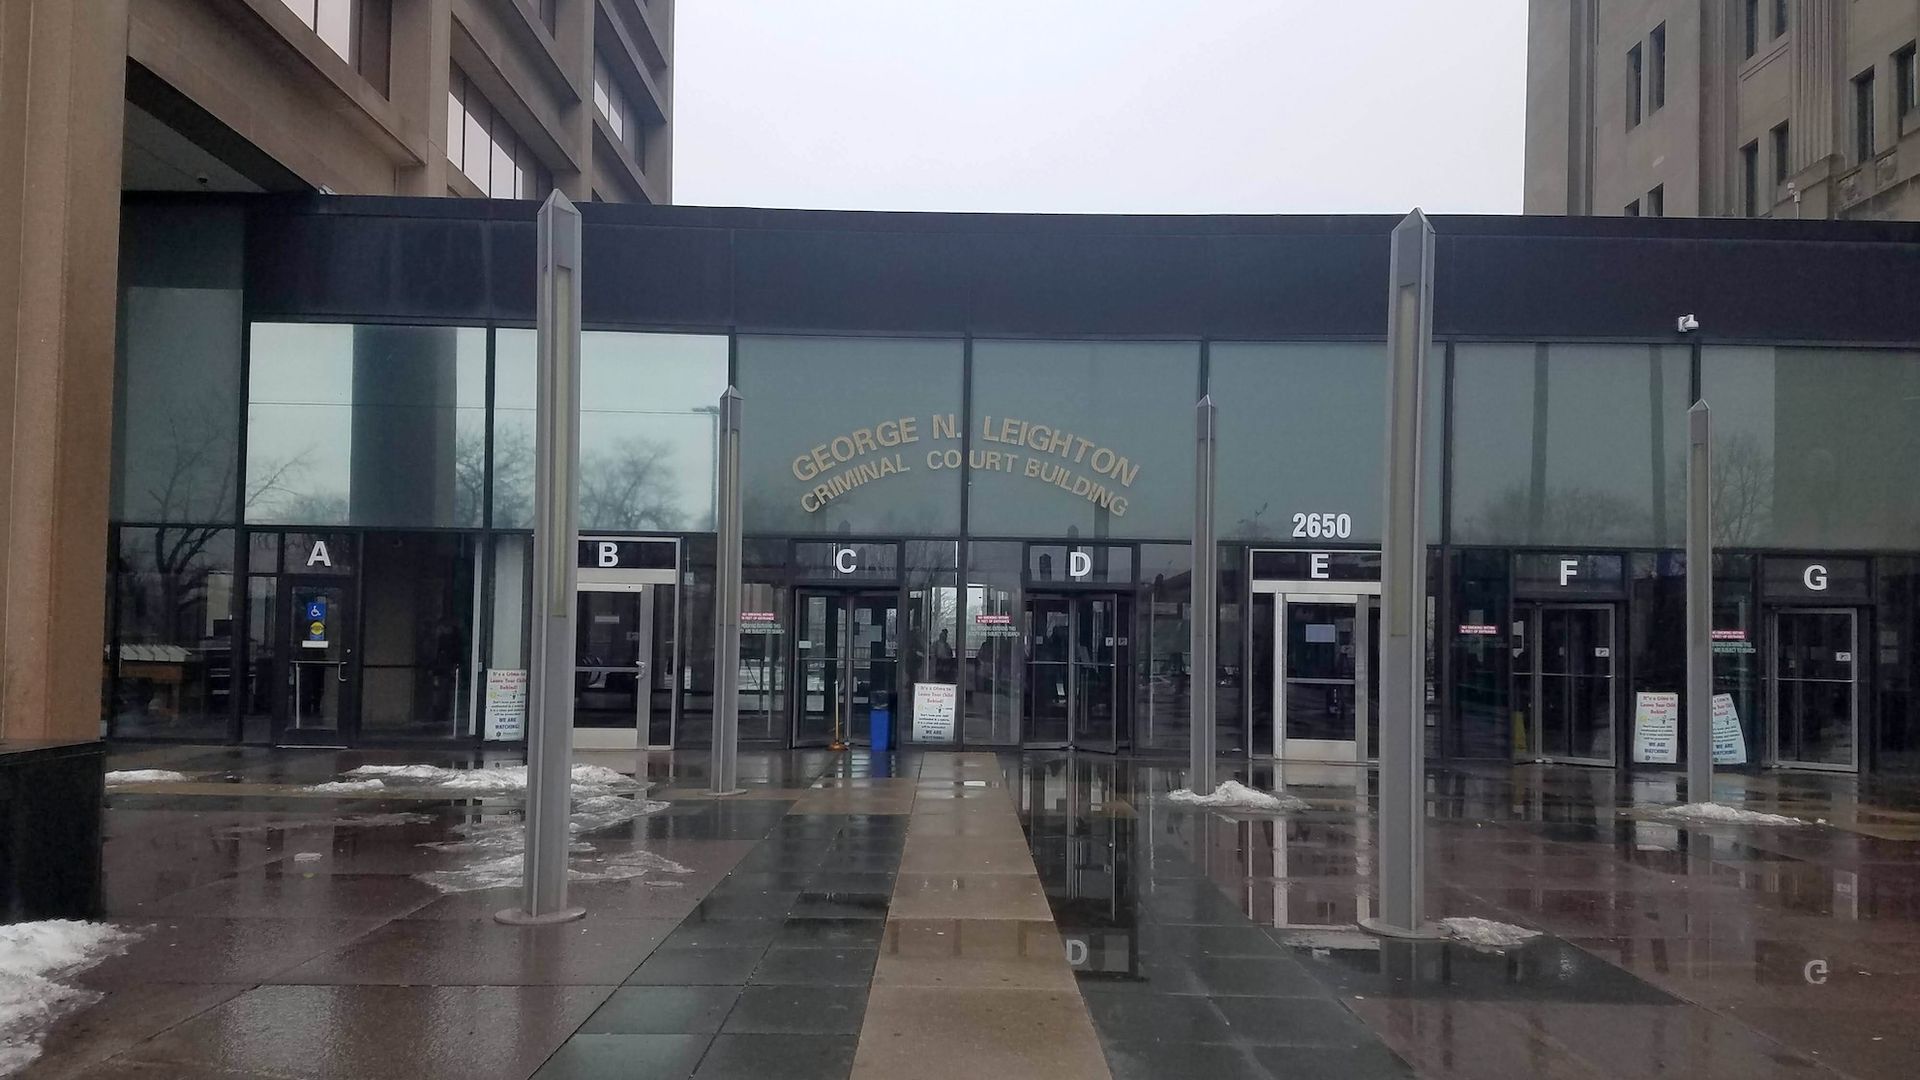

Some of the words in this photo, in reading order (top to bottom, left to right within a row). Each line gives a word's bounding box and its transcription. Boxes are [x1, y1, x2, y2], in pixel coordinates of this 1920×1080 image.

[792, 416, 919, 481] GEORGE
[932, 414, 962, 439] N.
[983, 416, 1140, 487] LEIGHTON
[800, 454, 911, 513] CRIMINAL
[926, 450, 1019, 473] COURT
[1024, 458, 1129, 517] BUILDING
[1292, 512, 1352, 539] 2650
[306, 540, 332, 567] A
[598, 541, 619, 568] B
[835, 548, 857, 574] C
[1069, 551, 1092, 577] D
[1310, 553, 1330, 579] E
[1560, 560, 1578, 586] F
[1803, 564, 1828, 591] G
